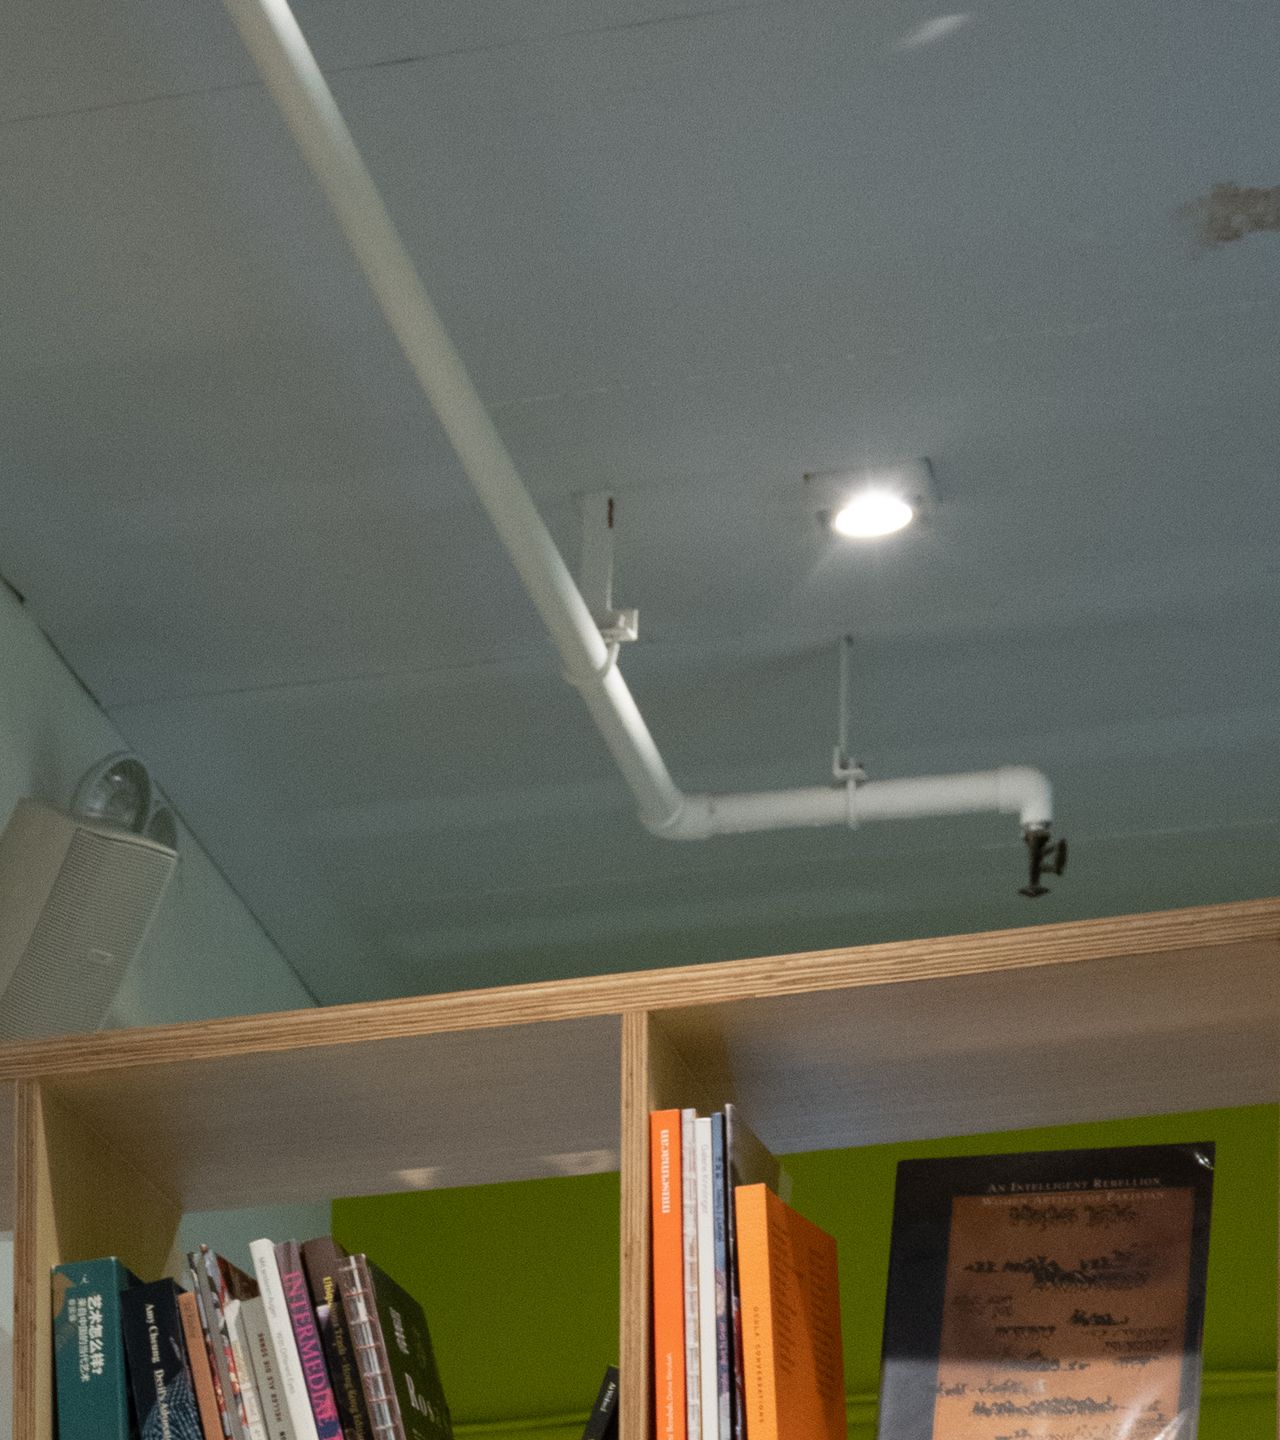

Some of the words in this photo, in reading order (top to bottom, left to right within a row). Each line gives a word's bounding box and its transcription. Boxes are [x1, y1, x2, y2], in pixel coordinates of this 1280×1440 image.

[87, 1294, 104, 1375] 艺术怎么样?
